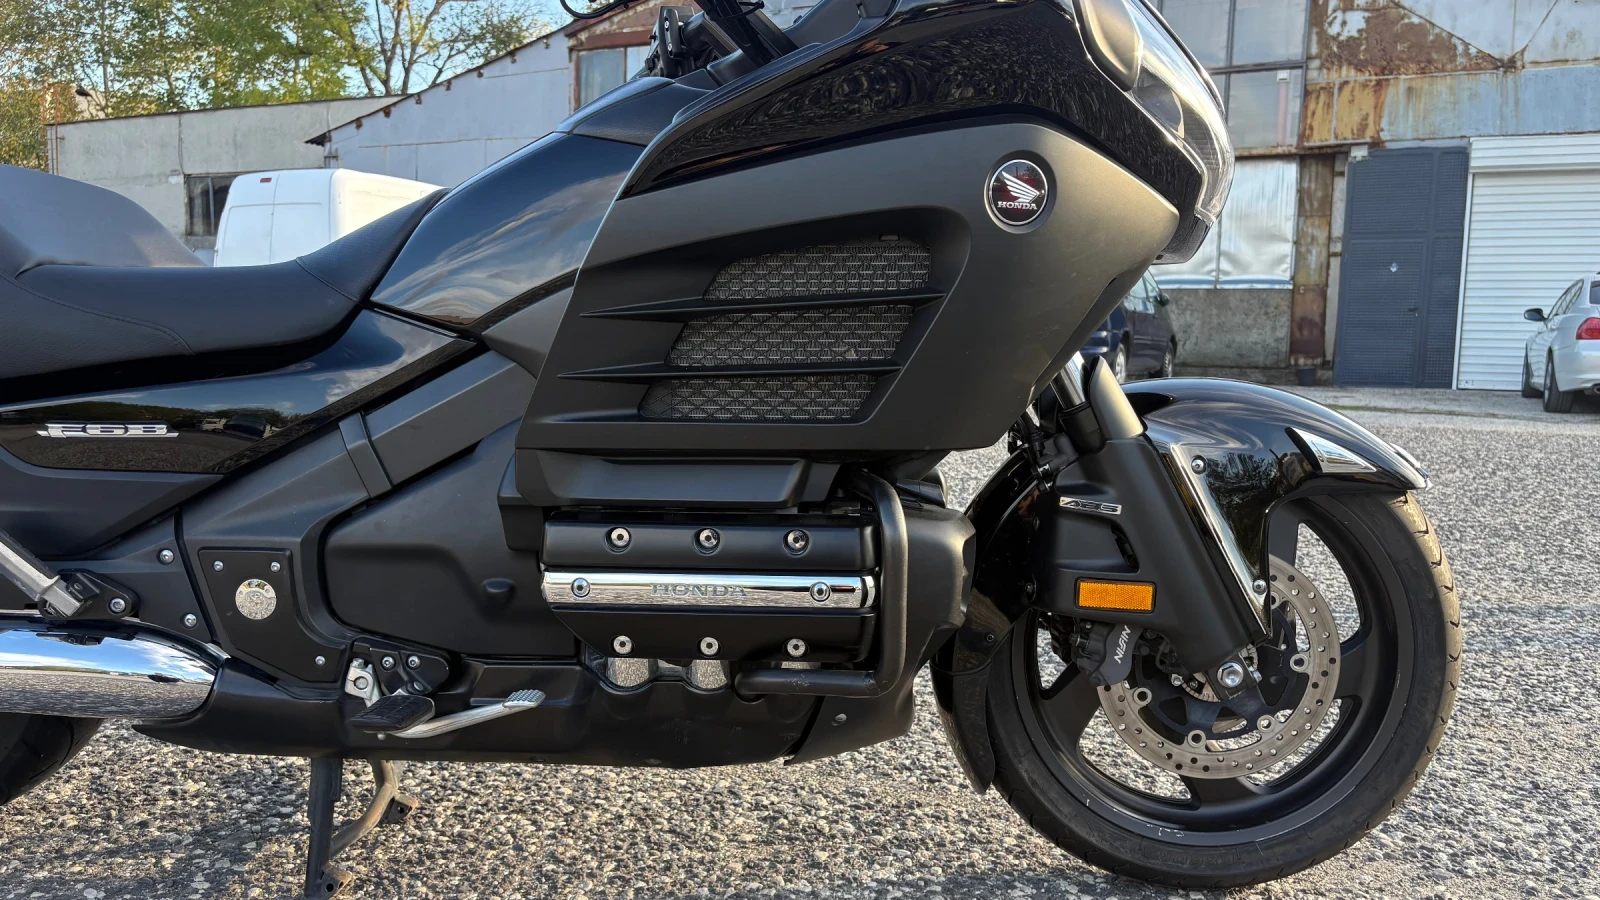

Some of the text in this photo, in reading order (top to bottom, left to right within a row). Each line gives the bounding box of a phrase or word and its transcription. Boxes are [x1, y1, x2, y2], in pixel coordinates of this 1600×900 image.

[997, 201, 1037, 210] HONDA
[41, 422, 173, 438] F6B
[1060, 497, 1121, 514] ABS
[649, 583, 748, 597] HONDA
